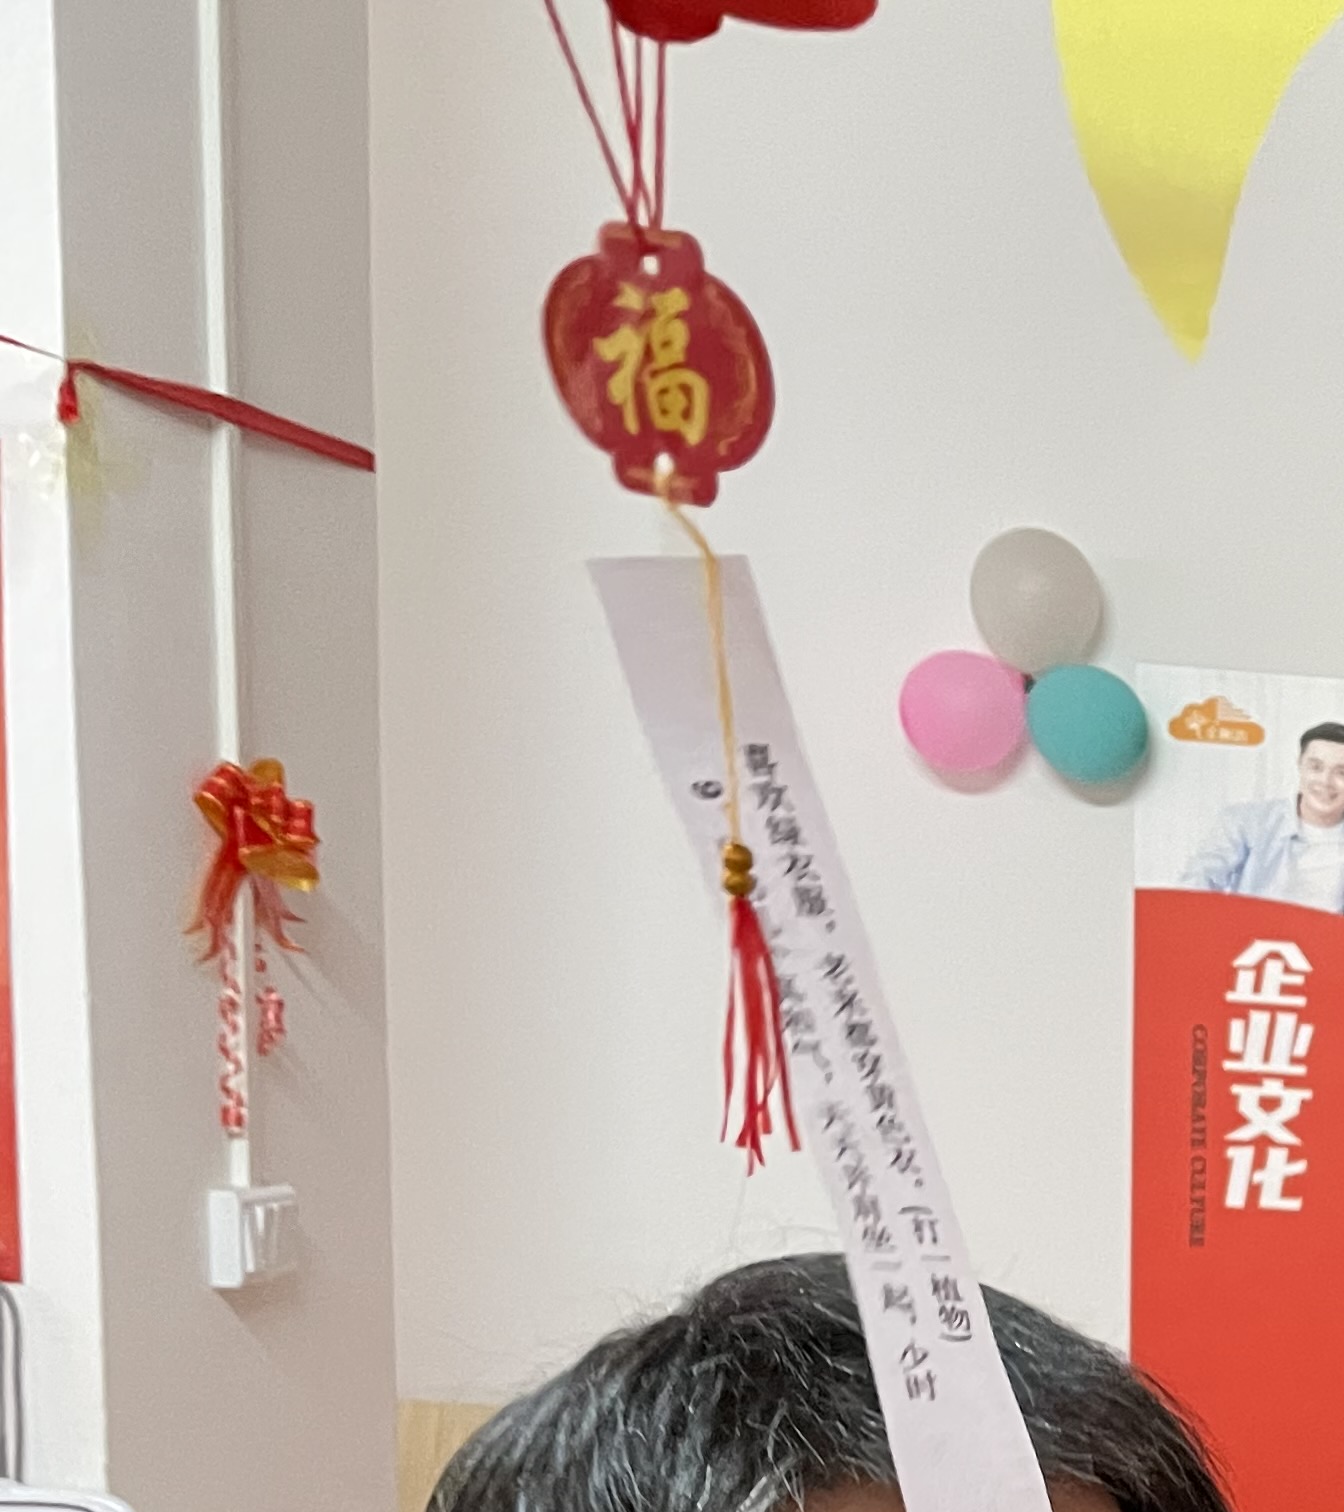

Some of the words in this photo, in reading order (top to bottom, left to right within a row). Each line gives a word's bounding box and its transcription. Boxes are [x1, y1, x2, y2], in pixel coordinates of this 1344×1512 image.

[592, 284, 709, 447] 福
[1222, 939, 1314, 1211] 企业文化
